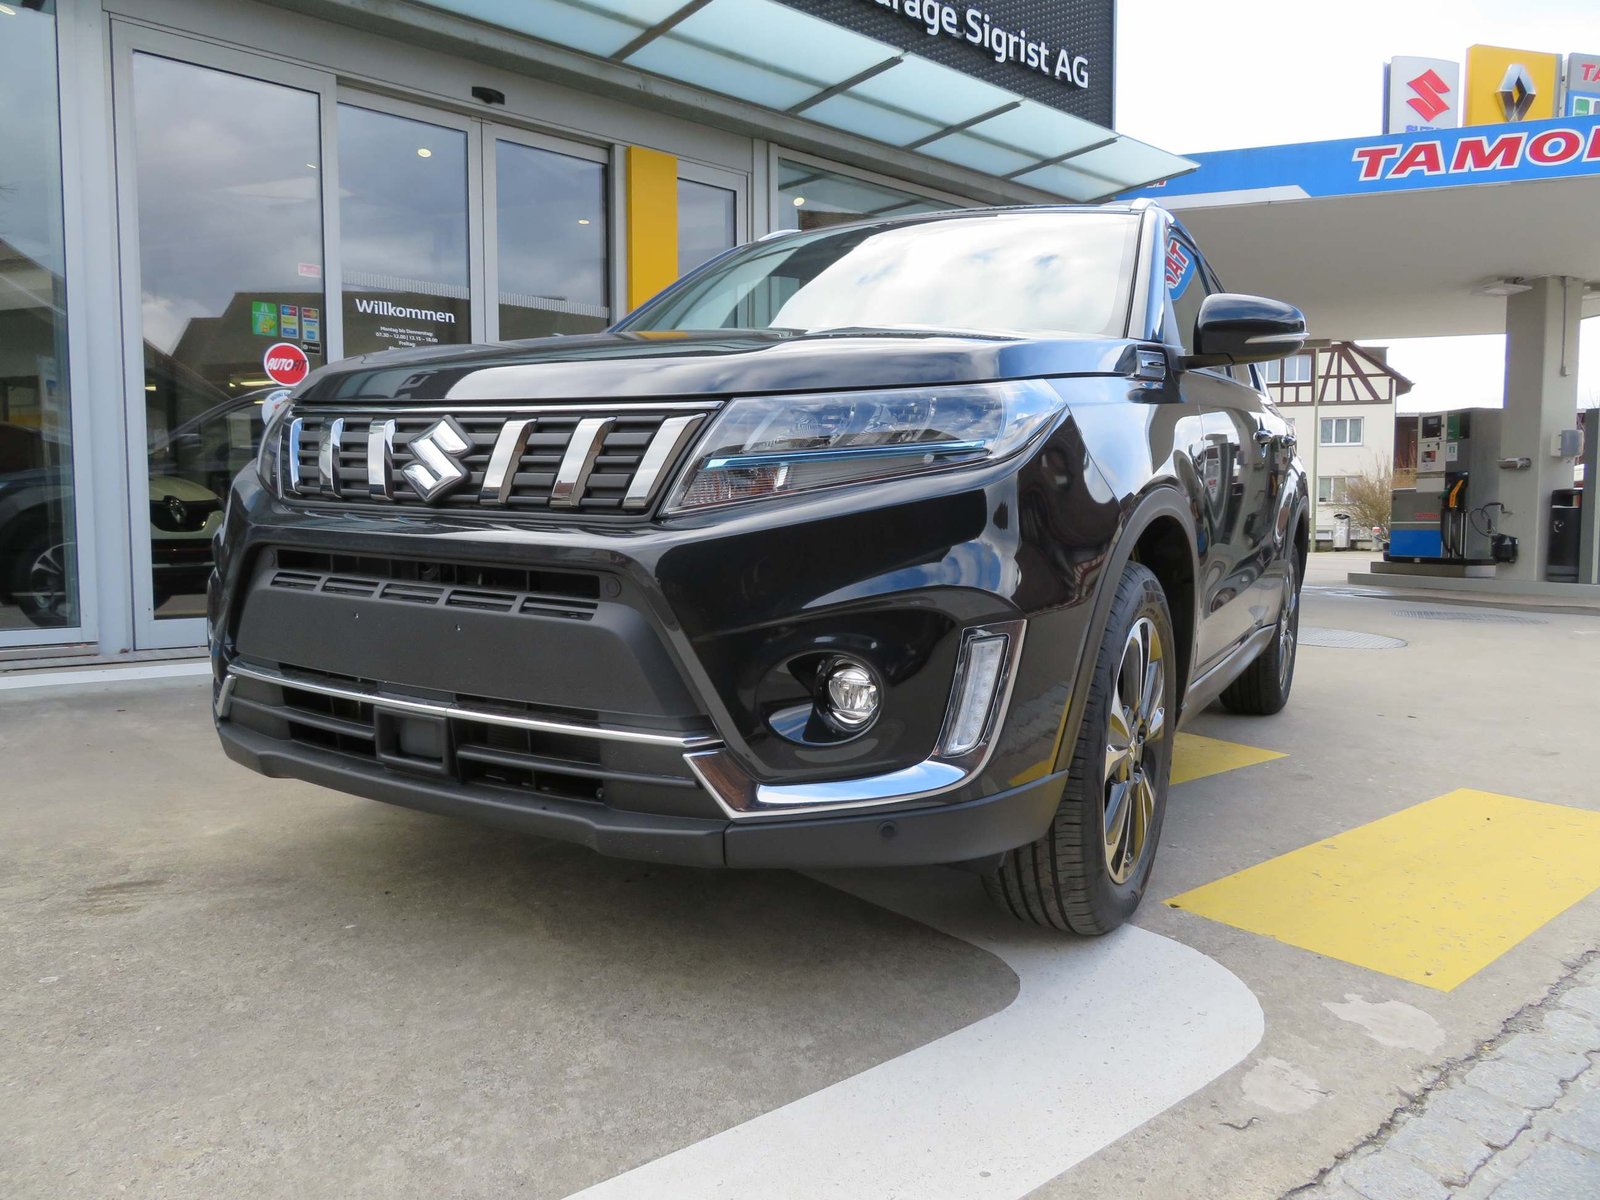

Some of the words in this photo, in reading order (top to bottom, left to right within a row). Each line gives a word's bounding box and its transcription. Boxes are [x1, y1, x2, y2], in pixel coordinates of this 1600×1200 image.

[966, 9, 1049, 73] Sigrist
[1055, 50, 1089, 89] AG
[355, 299, 456, 323] Willkommen
